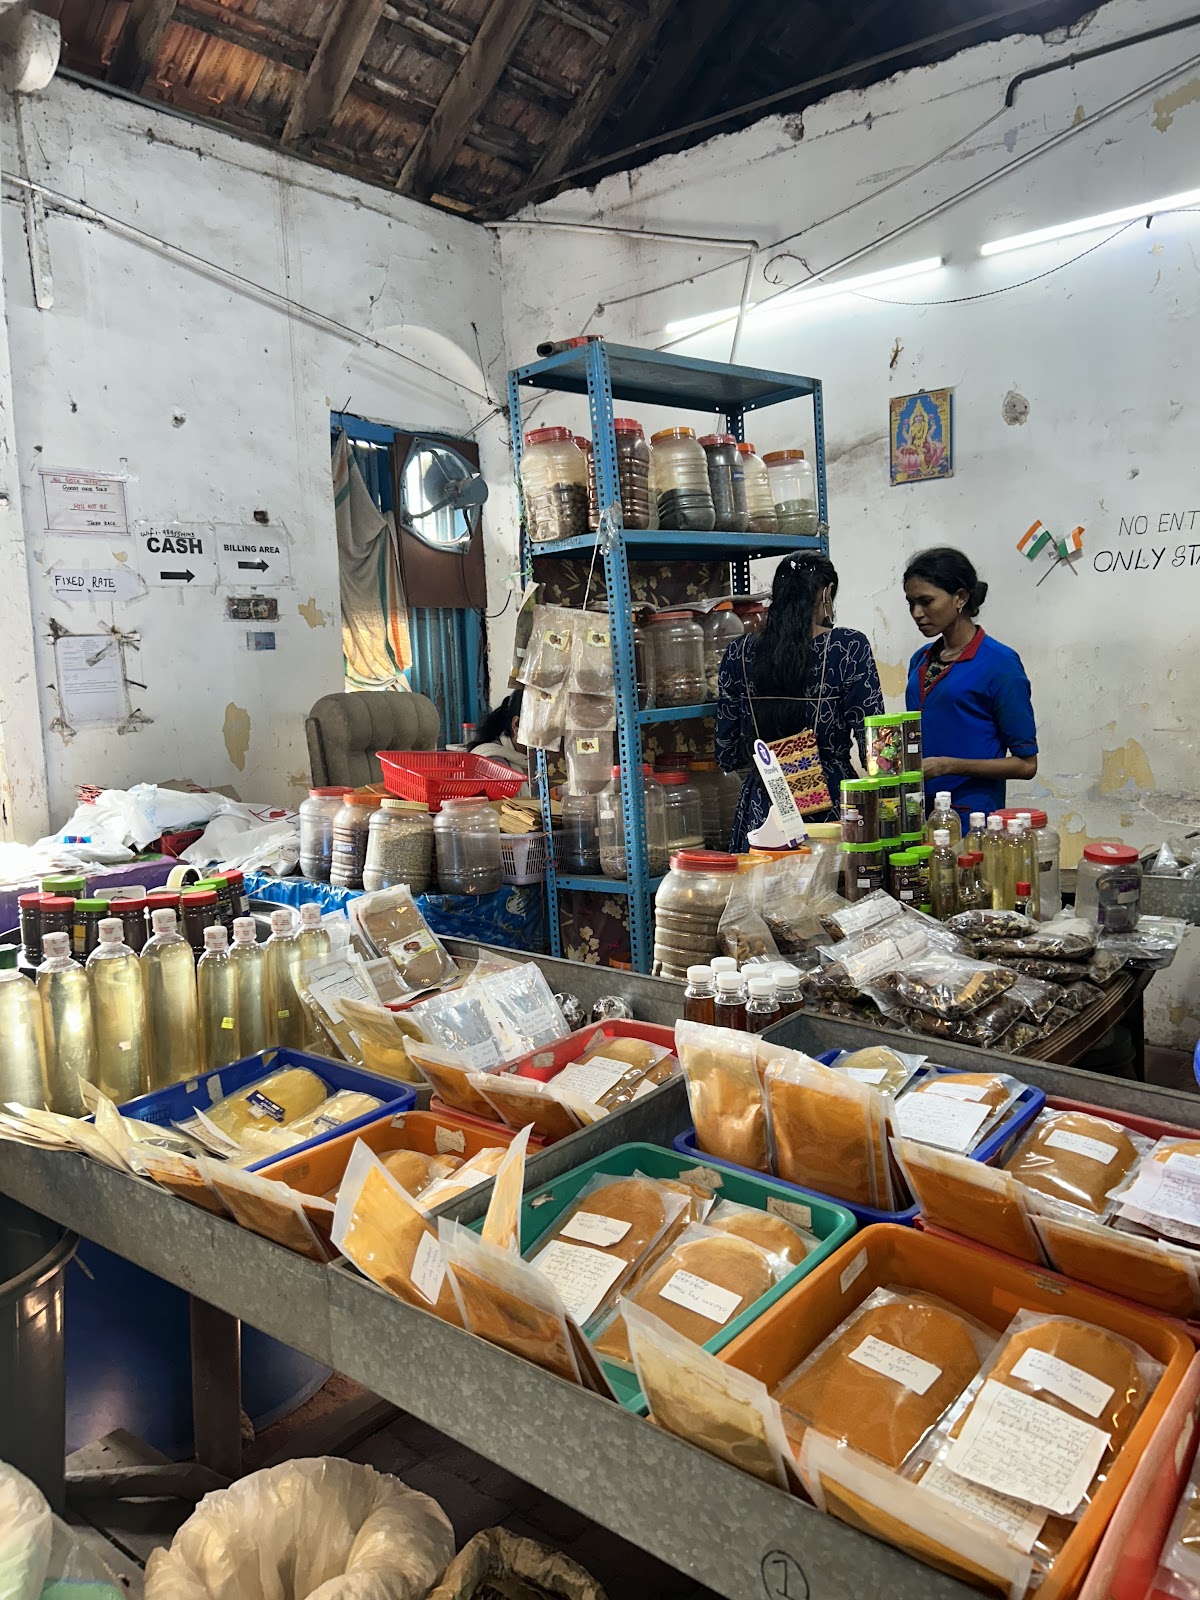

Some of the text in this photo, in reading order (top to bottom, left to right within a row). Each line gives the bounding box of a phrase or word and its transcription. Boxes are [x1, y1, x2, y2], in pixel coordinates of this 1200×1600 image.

[1119, 516, 1148, 536] NO
[147, 537, 203, 554] CASH
[223, 544, 280, 554] BILLING AREA
[1094, 547, 1166, 572] ONLY
[54, 575, 116, 588] FIXED RATE
